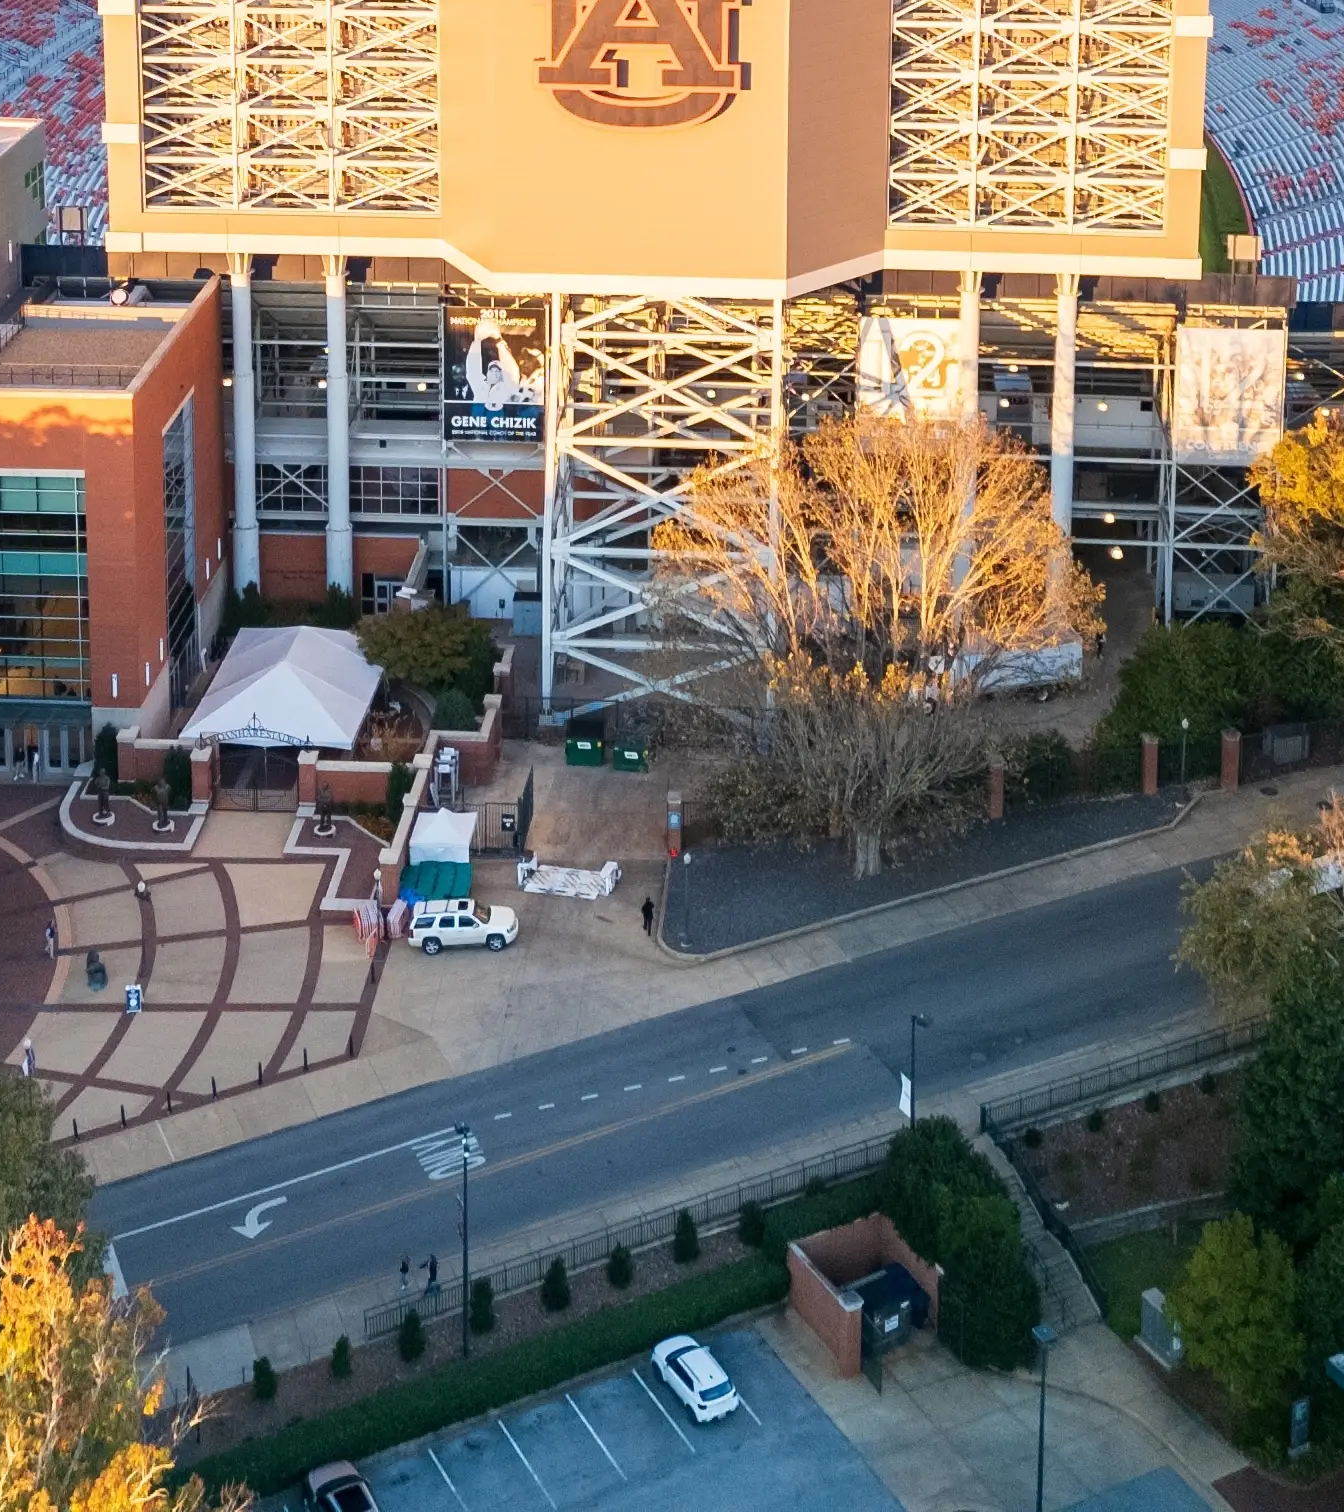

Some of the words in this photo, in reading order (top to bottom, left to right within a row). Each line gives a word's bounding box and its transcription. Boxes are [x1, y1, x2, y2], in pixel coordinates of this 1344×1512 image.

[480, 309, 507, 319] 2010
[451, 416, 487, 428] GENE
[490, 417, 537, 429] CHIZIK
[412, 1131, 486, 1180] ONLY
